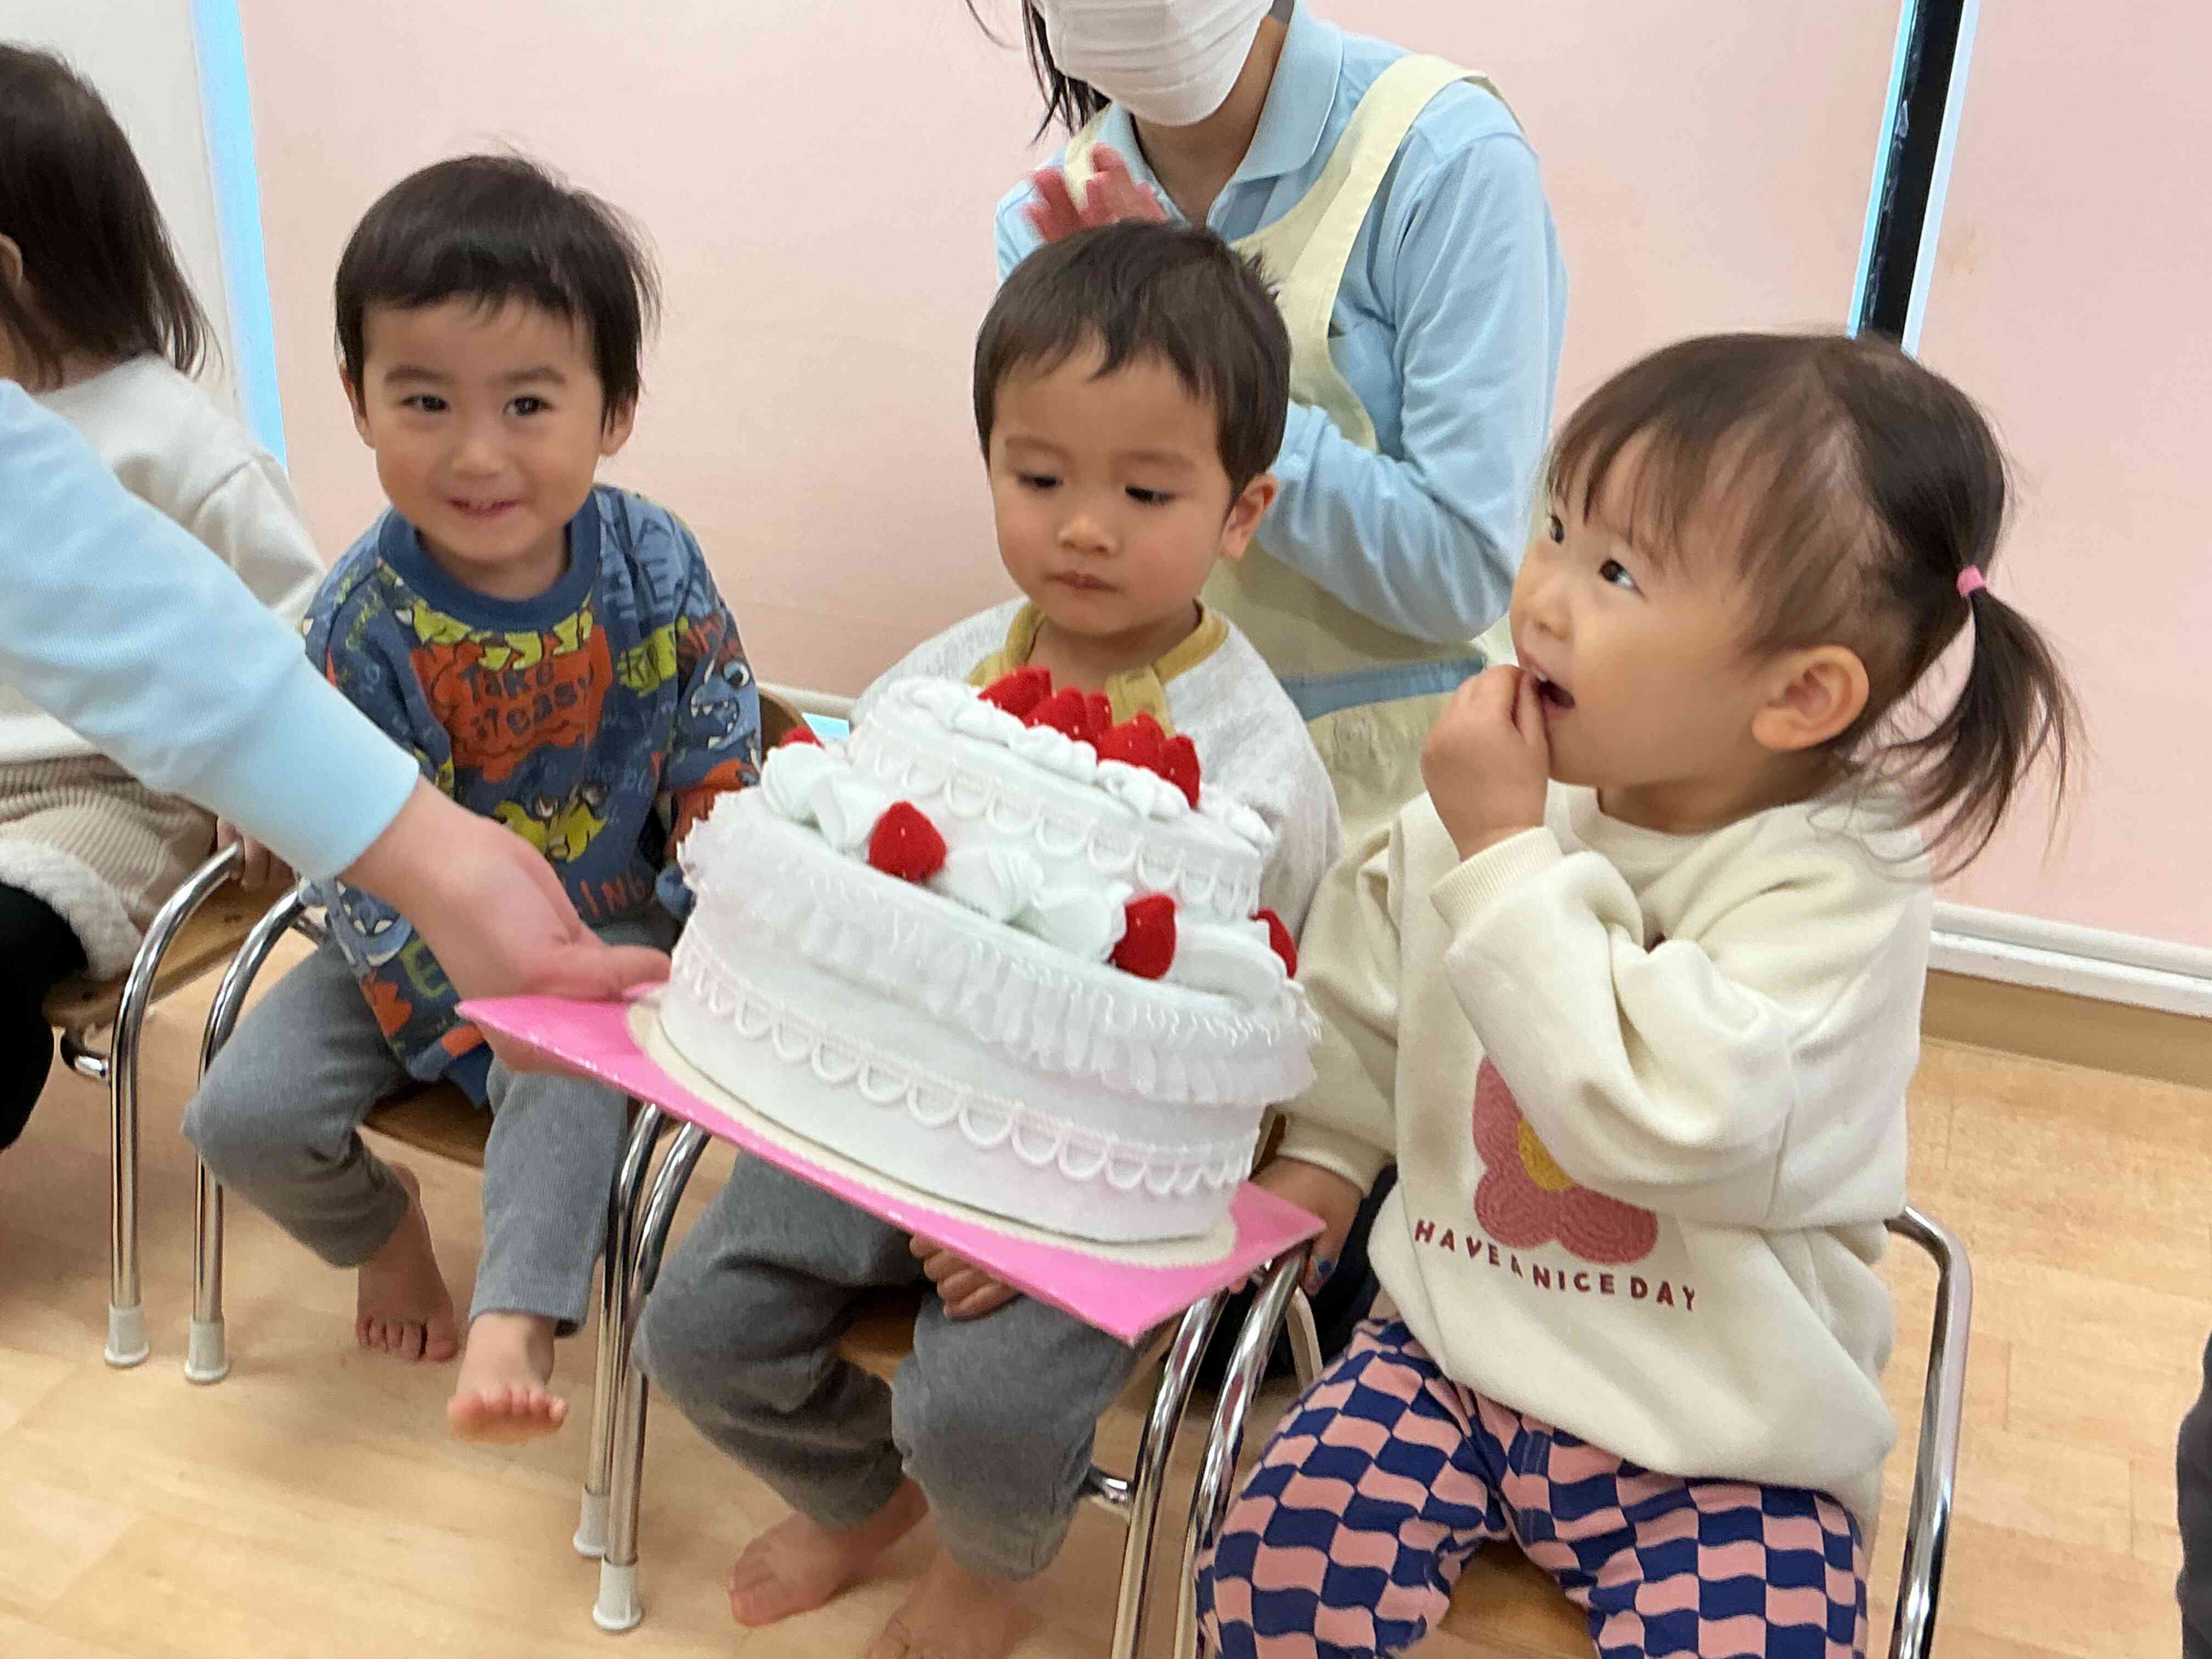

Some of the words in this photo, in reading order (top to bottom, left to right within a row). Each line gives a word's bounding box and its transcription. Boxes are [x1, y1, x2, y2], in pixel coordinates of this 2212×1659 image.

[1414, 1219, 1501, 1267] HAVE
[1510, 1253, 1523, 1278] A
[1532, 1263, 1616, 1296] NICE
[1630, 1275, 1695, 1312] DAY
